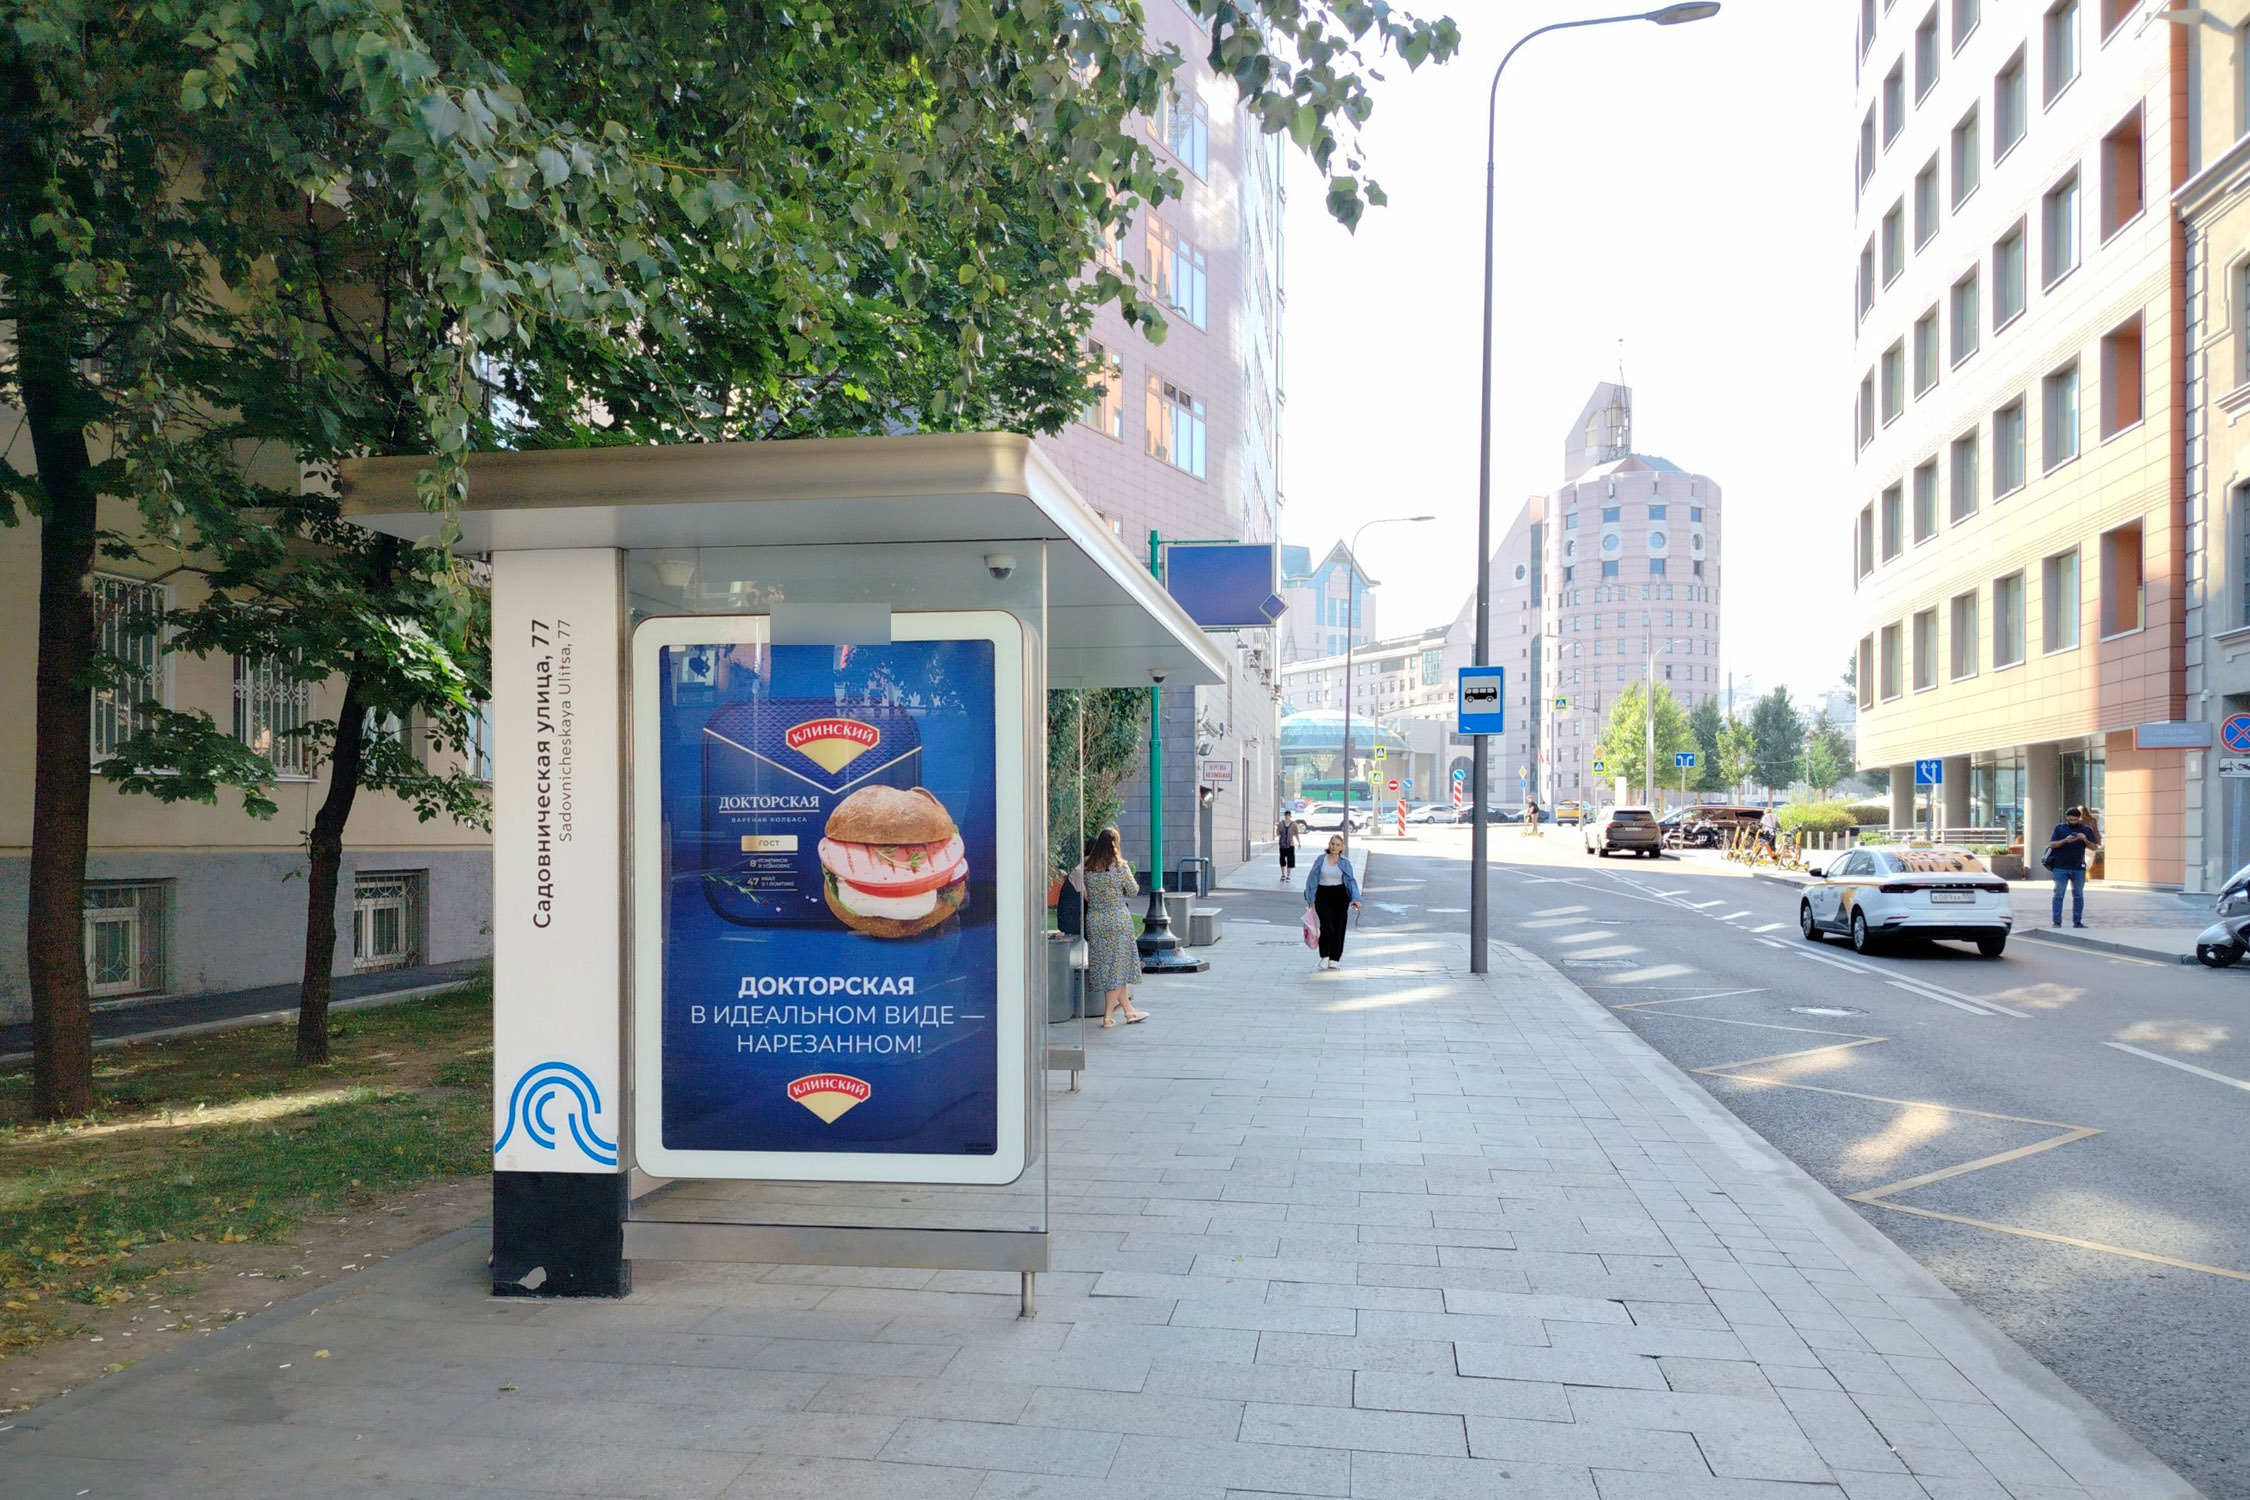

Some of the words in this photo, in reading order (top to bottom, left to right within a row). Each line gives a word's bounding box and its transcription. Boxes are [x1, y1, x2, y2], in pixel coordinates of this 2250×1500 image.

[532, 619, 549, 647] 77
[558, 619, 570, 638] 77
[558, 643, 573, 694] Ulitsa,
[537, 655, 554, 733] улица,
[792, 724, 874, 744] КЛИНСКИЙ
[558, 700, 574, 842] Sadovnicheskaya
[719, 796, 820, 810] ДОКТОРСКАЯ
[533, 741, 554, 928] Садовническая
[747, 877, 759, 886] 47
[738, 976, 915, 998] ДОКТОРСКАЯ
[691, 1006, 706, 1023] В
[714, 1006, 876, 1027] ИДЕАЛЬНОМ
[886, 1006, 954, 1027] ВИДЕ
[737, 1035, 922, 1053] НАРЕЗАННОМ!
[793, 1079, 866, 1097] КЛИНСКИЙ
